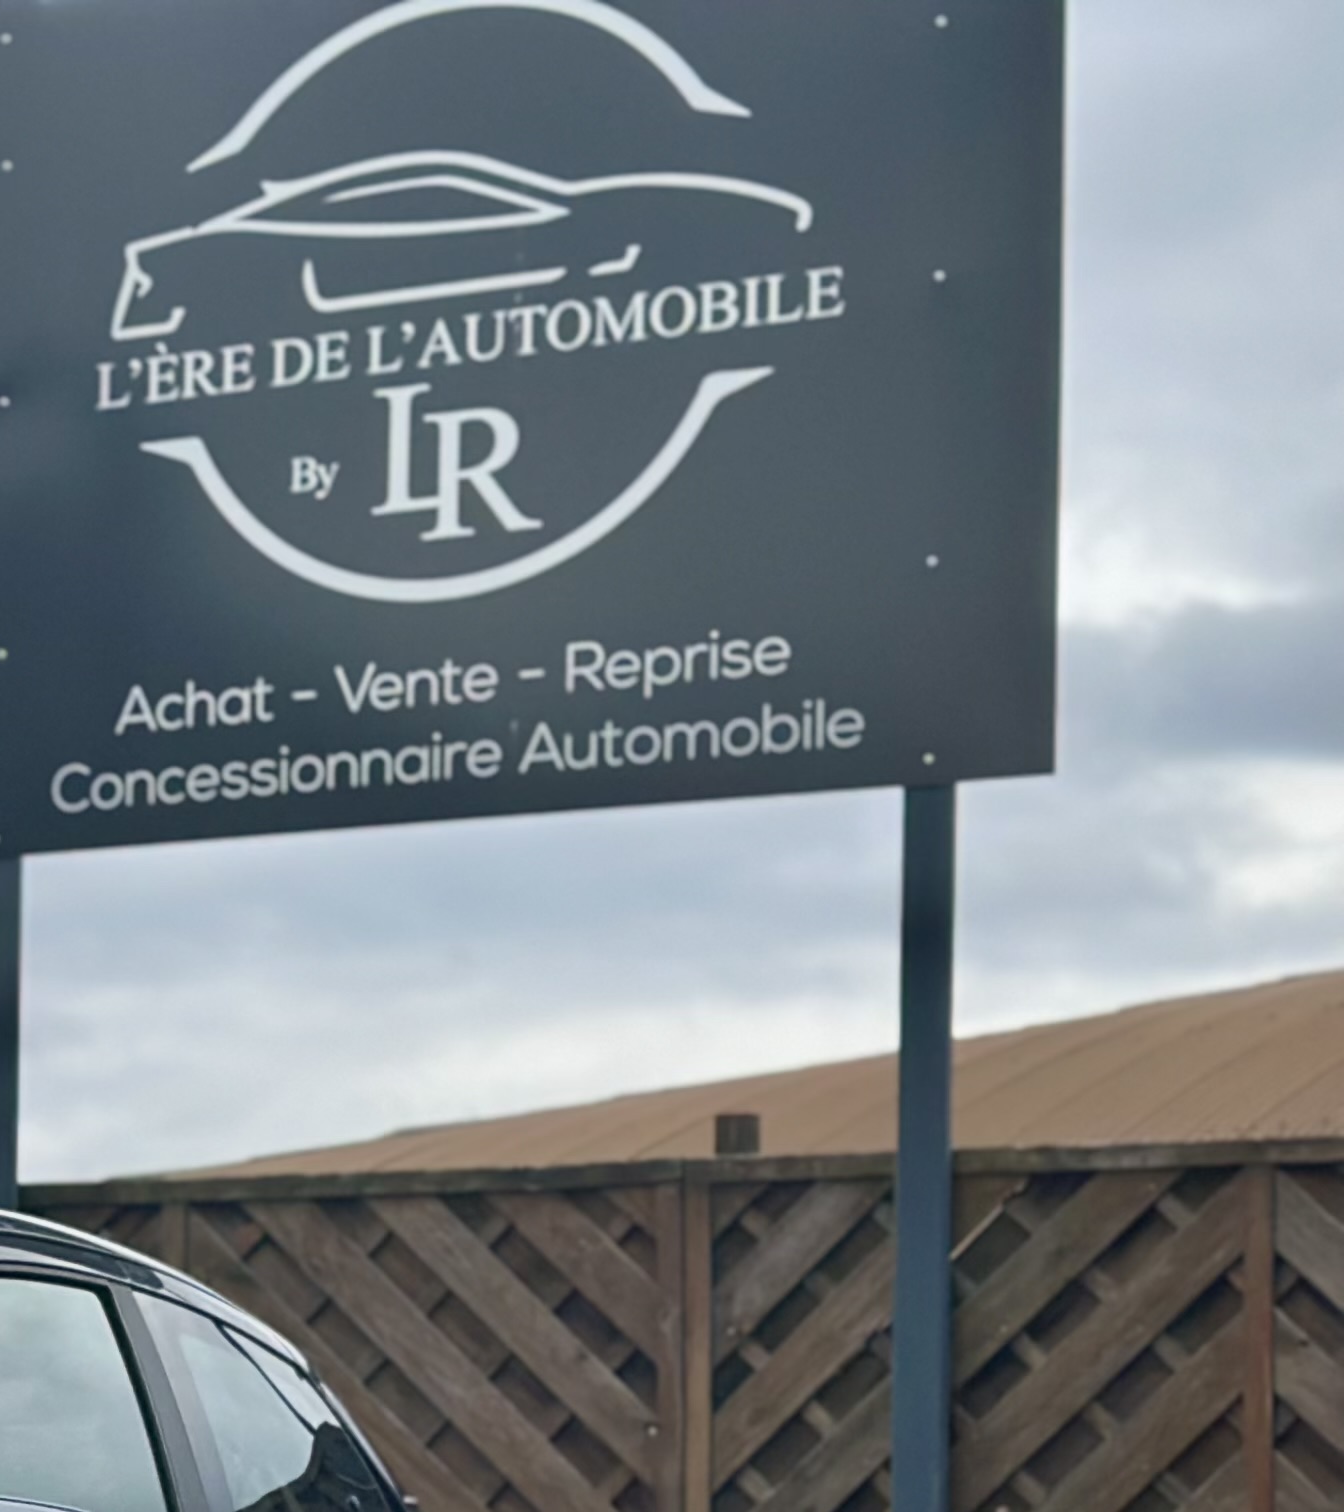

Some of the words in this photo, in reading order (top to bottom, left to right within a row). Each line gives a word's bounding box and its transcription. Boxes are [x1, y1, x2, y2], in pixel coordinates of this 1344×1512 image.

[96, 342, 256, 410] L'ÈRE
[269, 329, 352, 389] DE
[365, 265, 846, 377] L'AUTOMOBILE
[288, 455, 341, 502] By
[369, 382, 545, 542] LR
[115, 676, 274, 735] Achat
[292, 690, 317, 701] -
[333, 658, 500, 713] Vente
[518, 668, 545, 680] -
[564, 629, 793, 699] Reprise
[51, 738, 503, 813] Concessionnaire
[517, 698, 866, 774] Automobile
